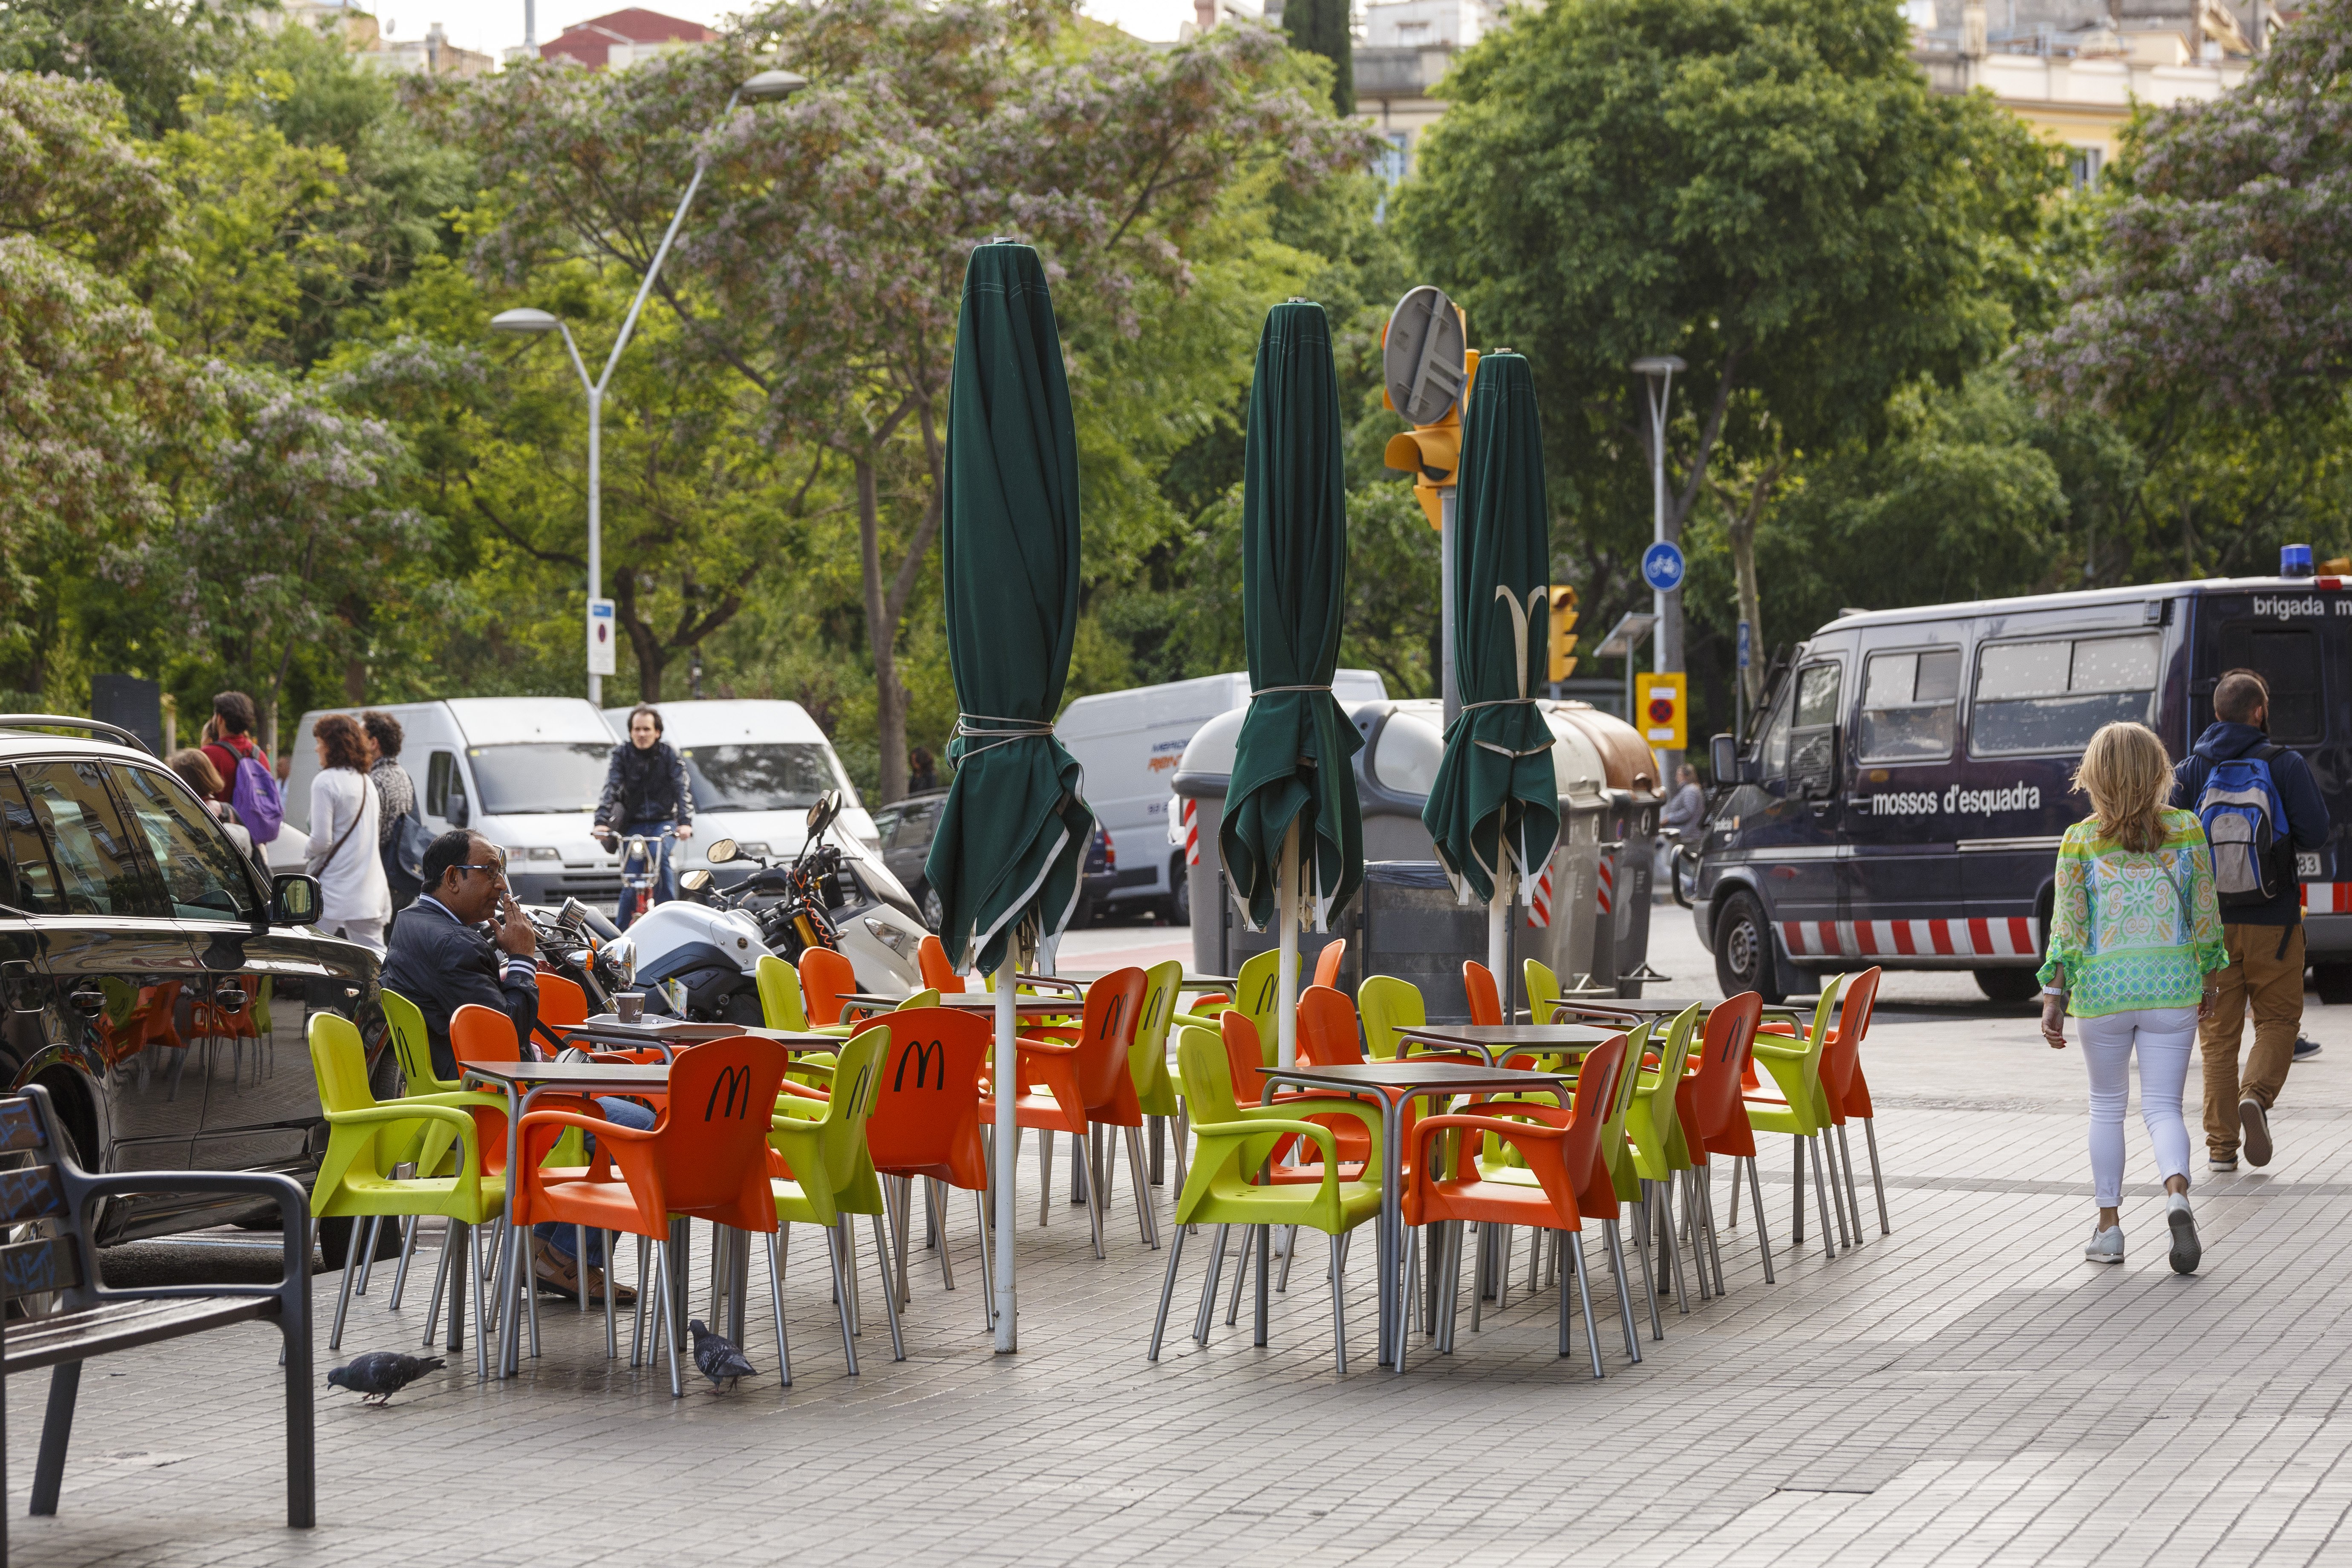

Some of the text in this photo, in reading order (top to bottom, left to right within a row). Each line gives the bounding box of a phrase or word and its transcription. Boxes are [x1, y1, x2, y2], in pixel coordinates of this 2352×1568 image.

[2253, 595, 2325, 621] brigada
[1872, 780, 2040, 817] mossos d'esquadra
